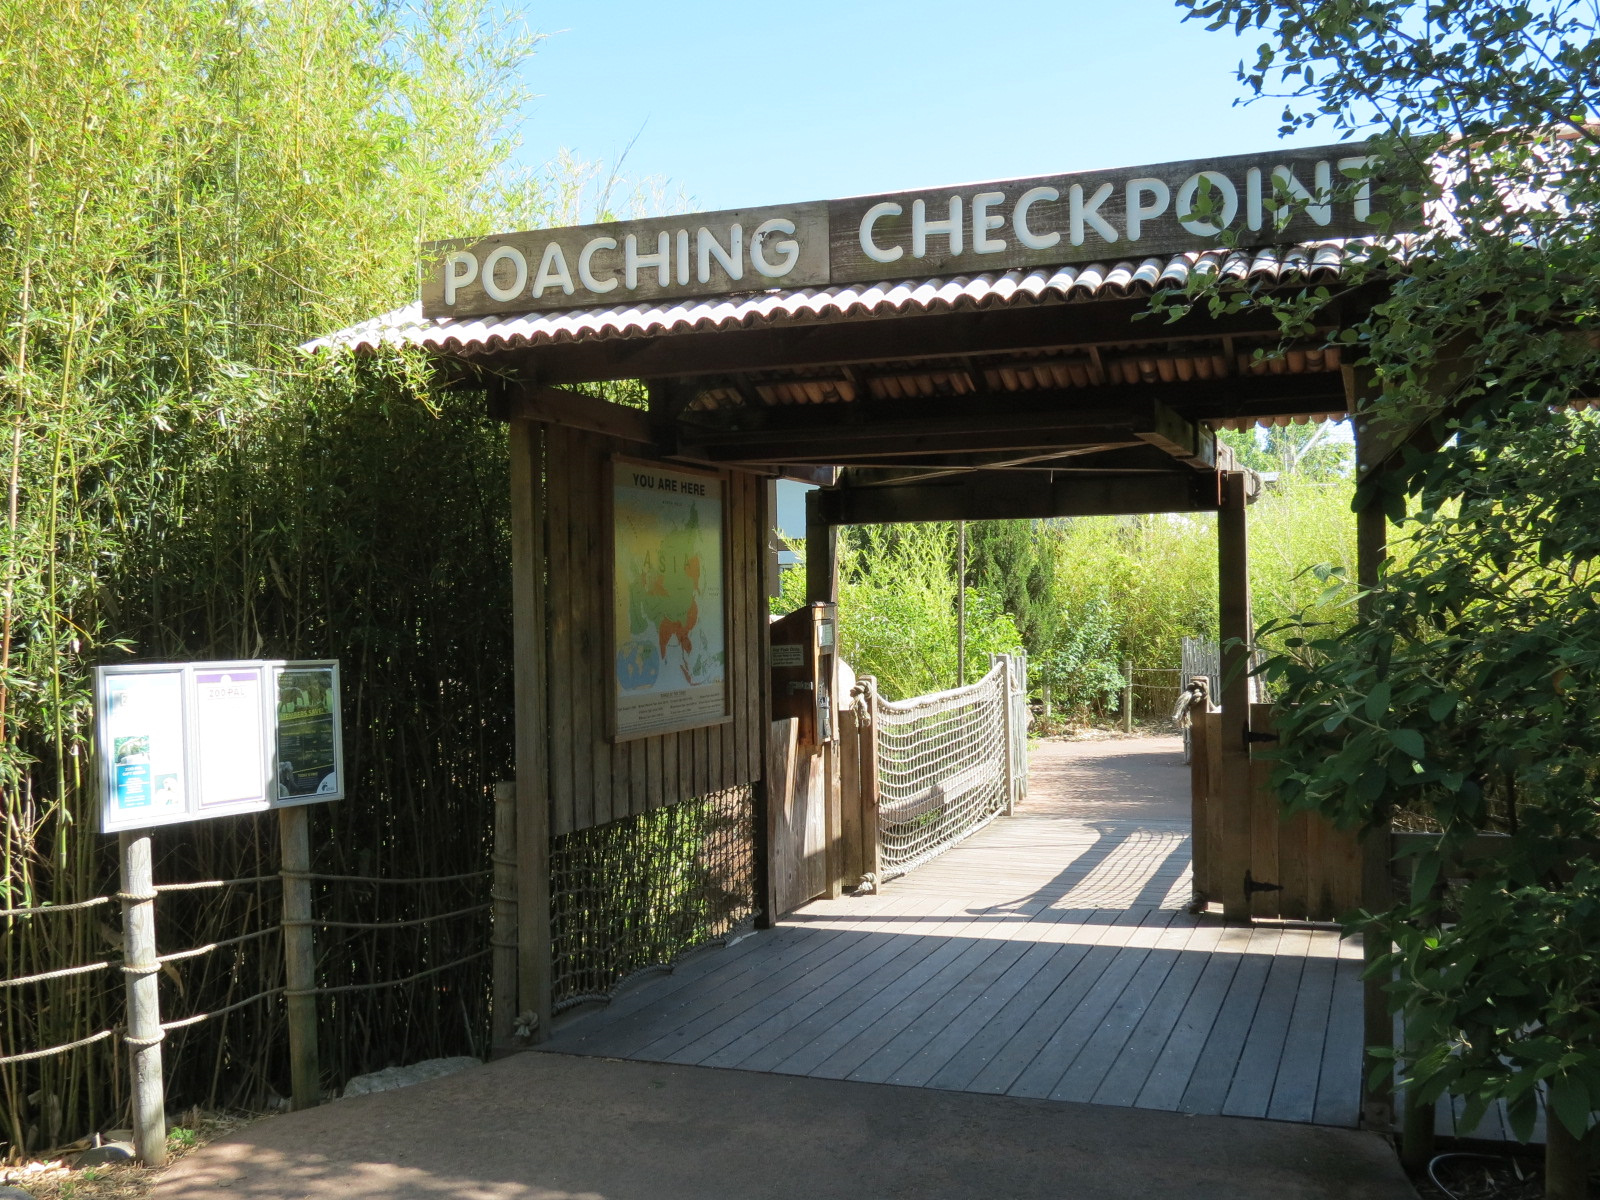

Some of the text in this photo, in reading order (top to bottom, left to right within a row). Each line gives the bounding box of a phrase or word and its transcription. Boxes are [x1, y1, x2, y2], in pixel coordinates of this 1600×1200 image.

[444, 154, 1385, 307] POACHING CHECKPOINT
[632, 473, 706, 496] YOU ARE HERE
